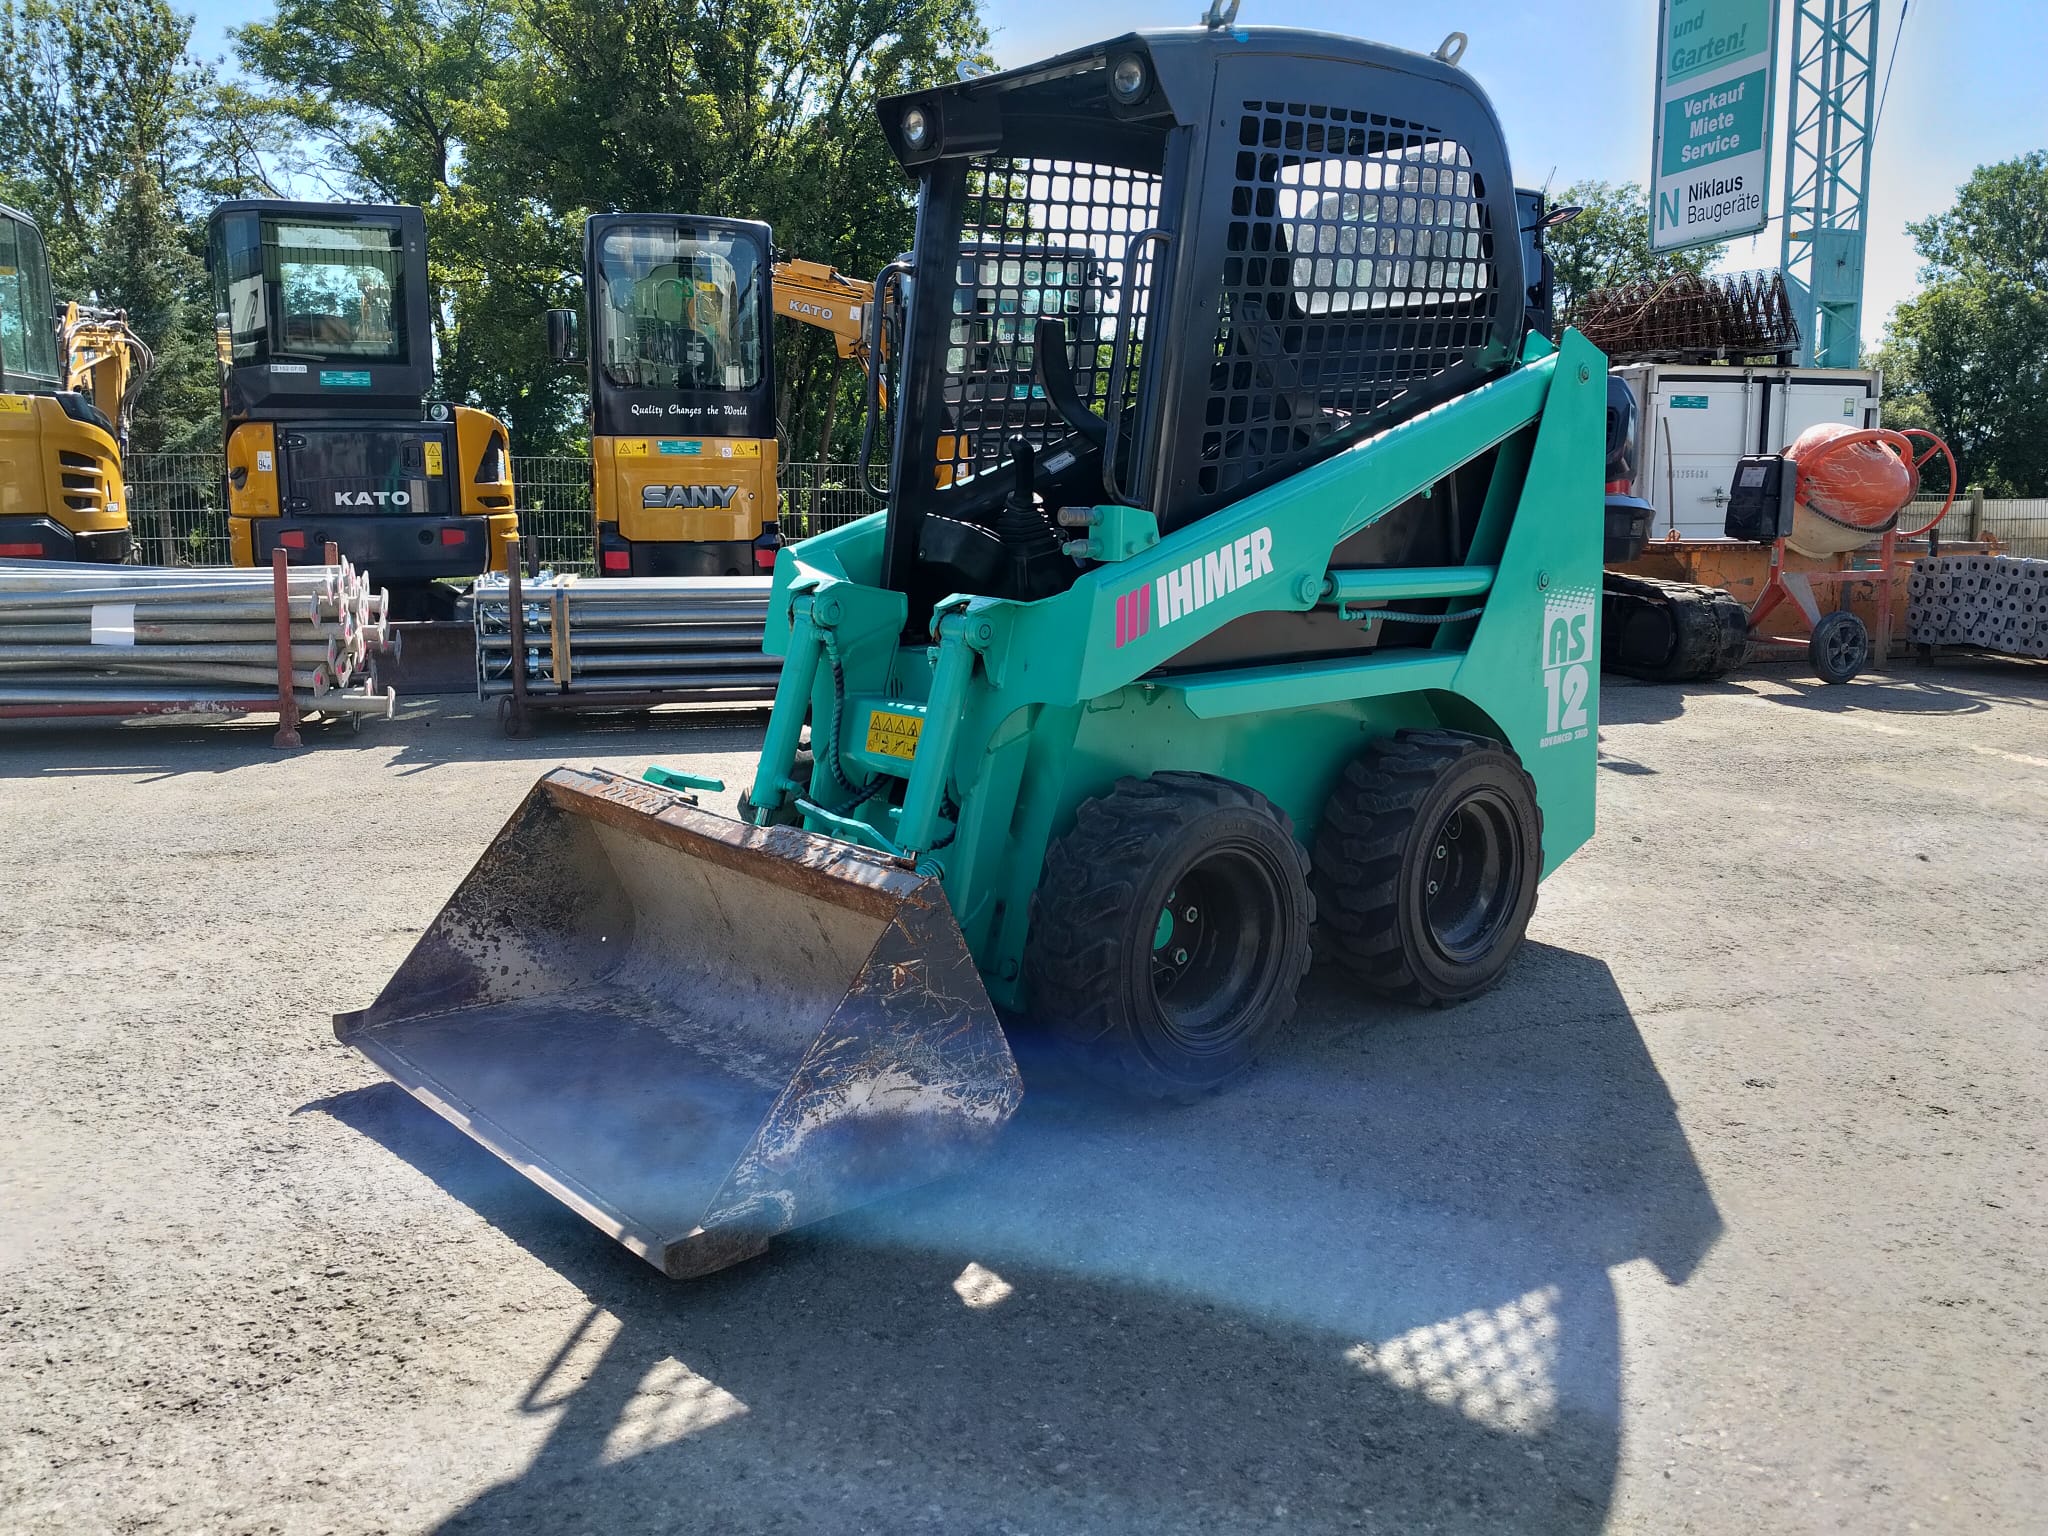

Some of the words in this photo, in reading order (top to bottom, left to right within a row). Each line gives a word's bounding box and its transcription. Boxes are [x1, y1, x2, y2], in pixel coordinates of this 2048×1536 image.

[1673, 8, 1705, 39] und
[1672, 22, 1748, 72] Garten!
[1684, 82, 1745, 118] Verkauf
[1690, 112, 1734, 139] Miete
[1681, 134, 1740, 163] Service
[1659, 188, 1680, 230] N
[1688, 175, 1743, 203] Niklaus
[1687, 193, 1760, 224] Baugeräte
[789, 300, 833, 320] KATO
[631, 404, 663, 418] Quality
[668, 404, 702, 418] Changes
[707, 405, 719, 415] the
[723, 405, 747, 416] World
[334, 491, 411, 506] KATO
[642, 484, 738, 509] SANY
[1156, 526, 1275, 628] IHIMER
[1549, 613, 1586, 665] AS
[1544, 664, 1589, 733] 12
